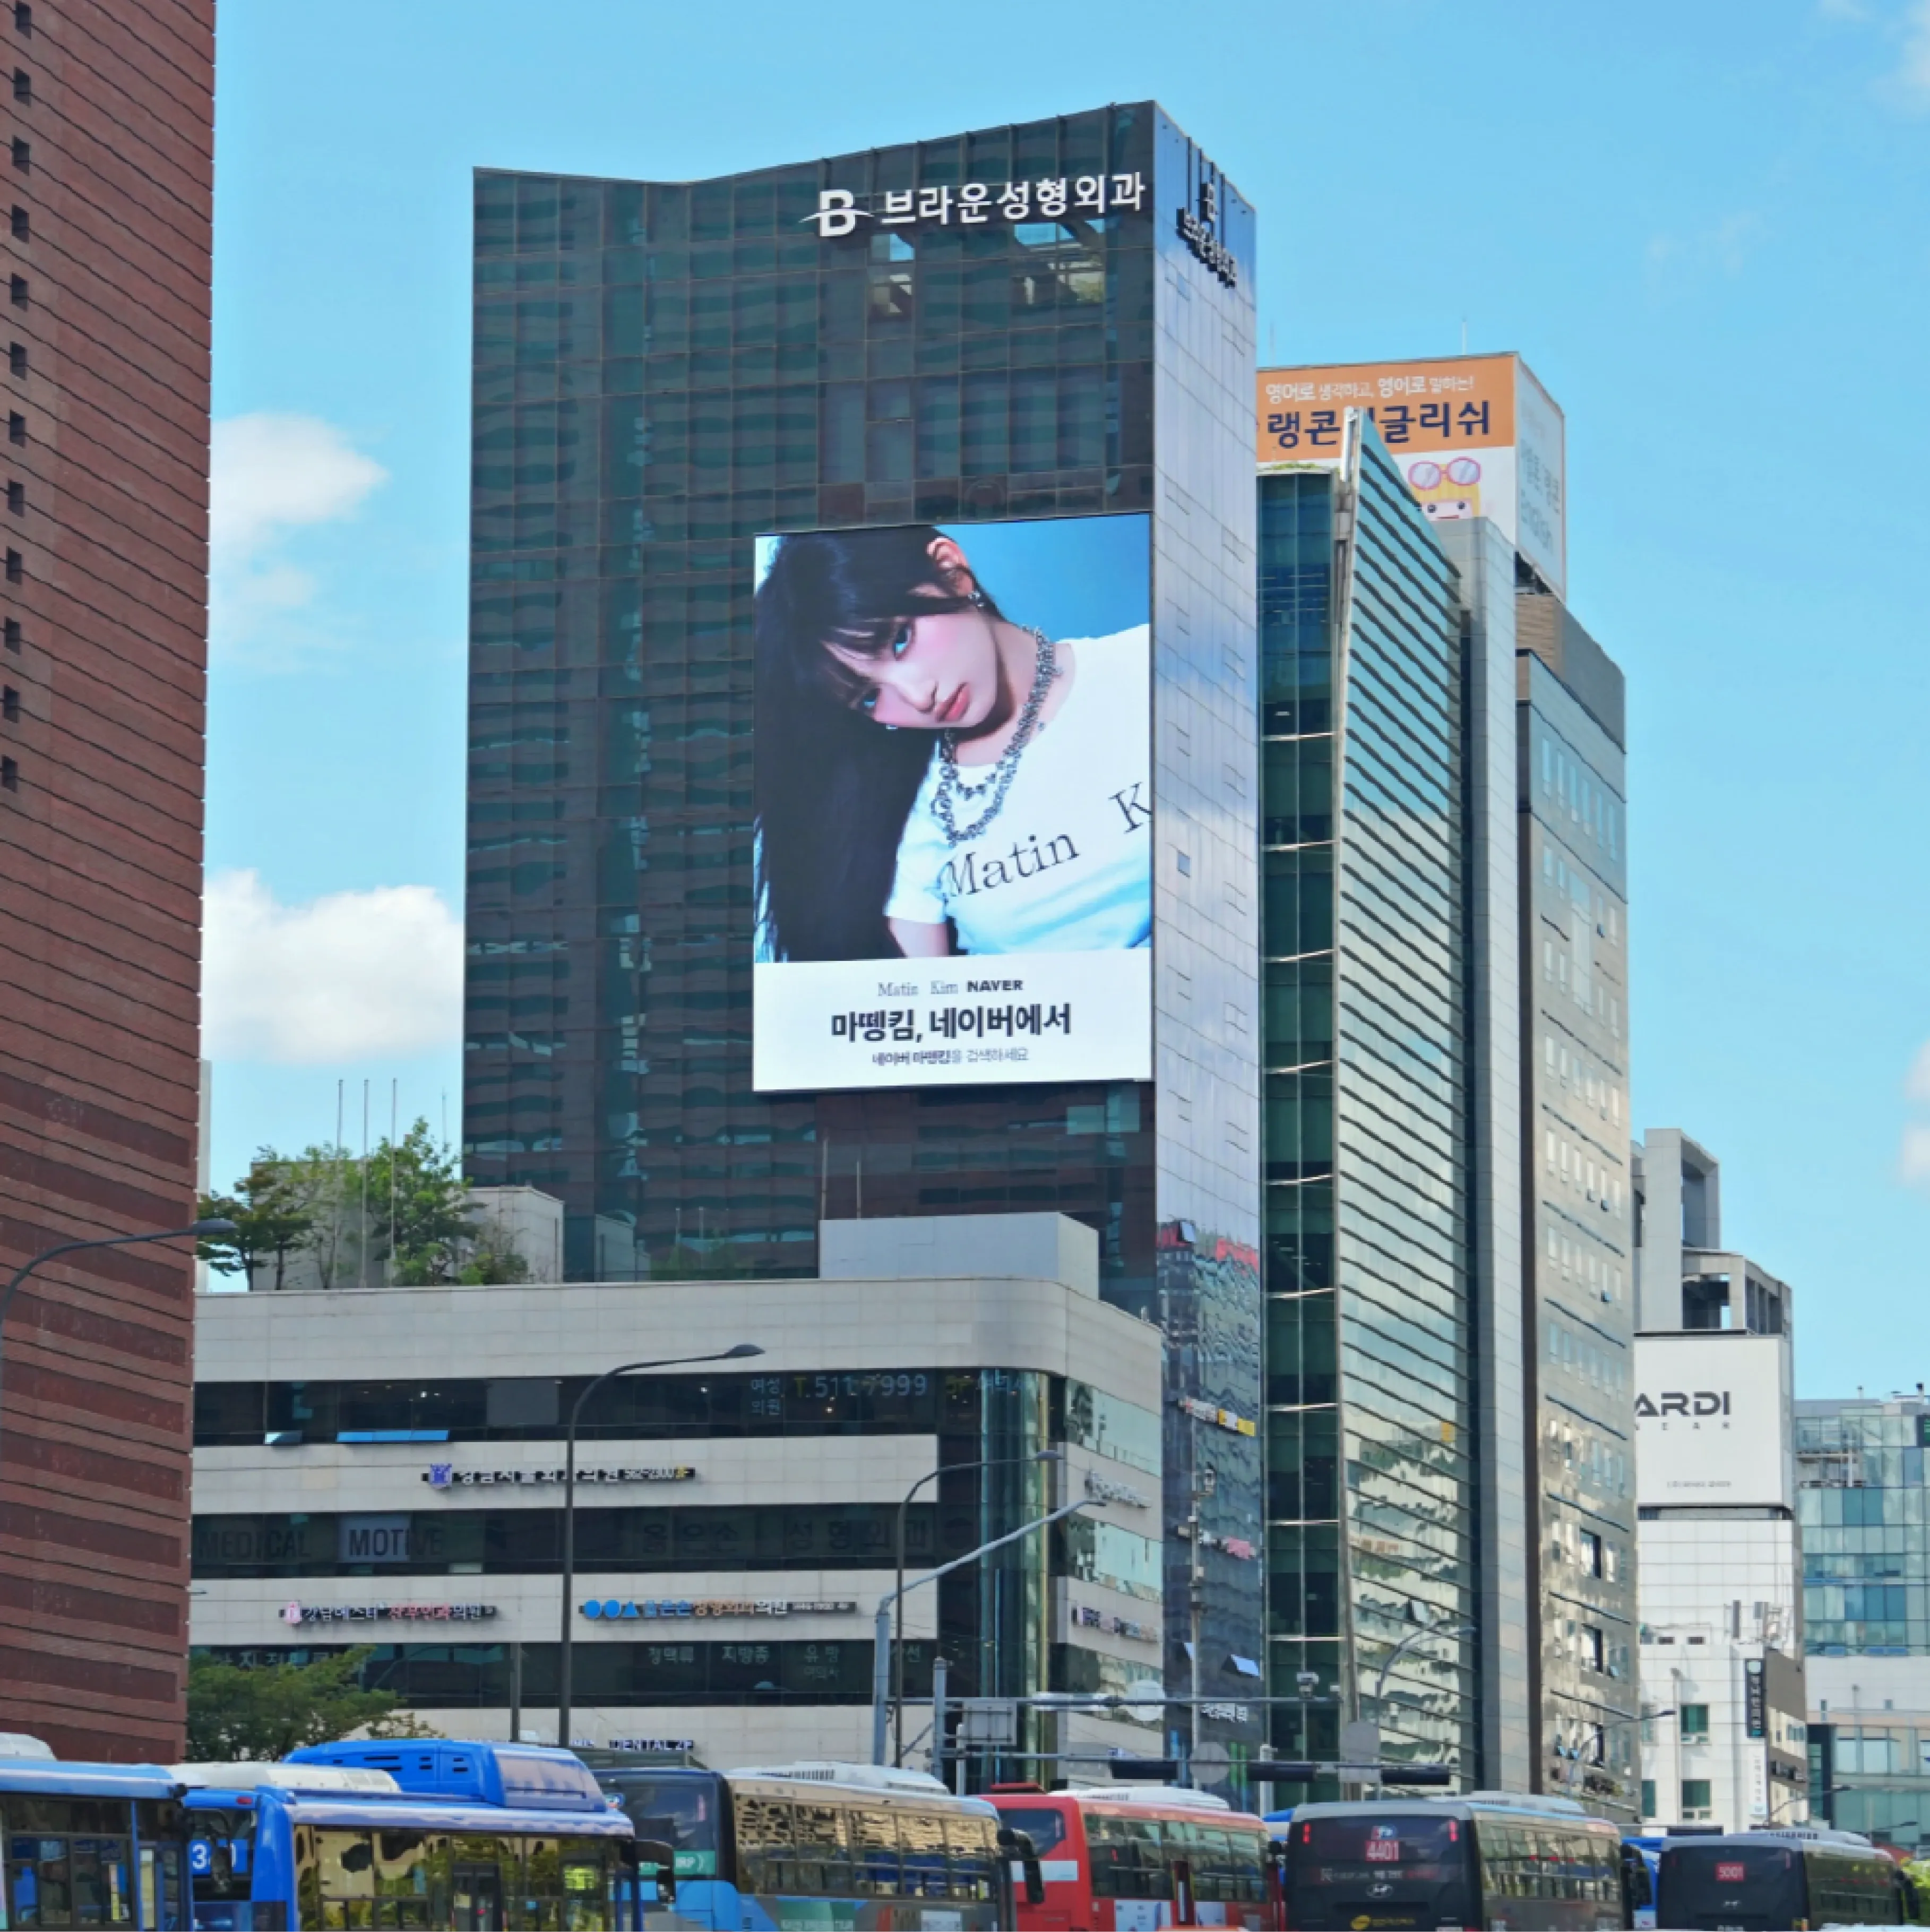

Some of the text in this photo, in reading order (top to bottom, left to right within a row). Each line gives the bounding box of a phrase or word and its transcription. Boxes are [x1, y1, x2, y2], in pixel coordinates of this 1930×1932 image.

[881, 171, 1147, 226] 브라운성형외과
[1265, 382, 1316, 404] 영어로
[1377, 375, 1427, 398] 영어로
[1266, 399, 1490, 449] 랭콘글리쉬
[943, 832, 1080, 897] Matin
[877, 981, 919, 997] Matin
[966, 979, 1024, 993] NAVER
[831, 1003, 1072, 1043] 마뗑킴, 네이버에서
[348, 1528, 444, 1557] MOTIVE
